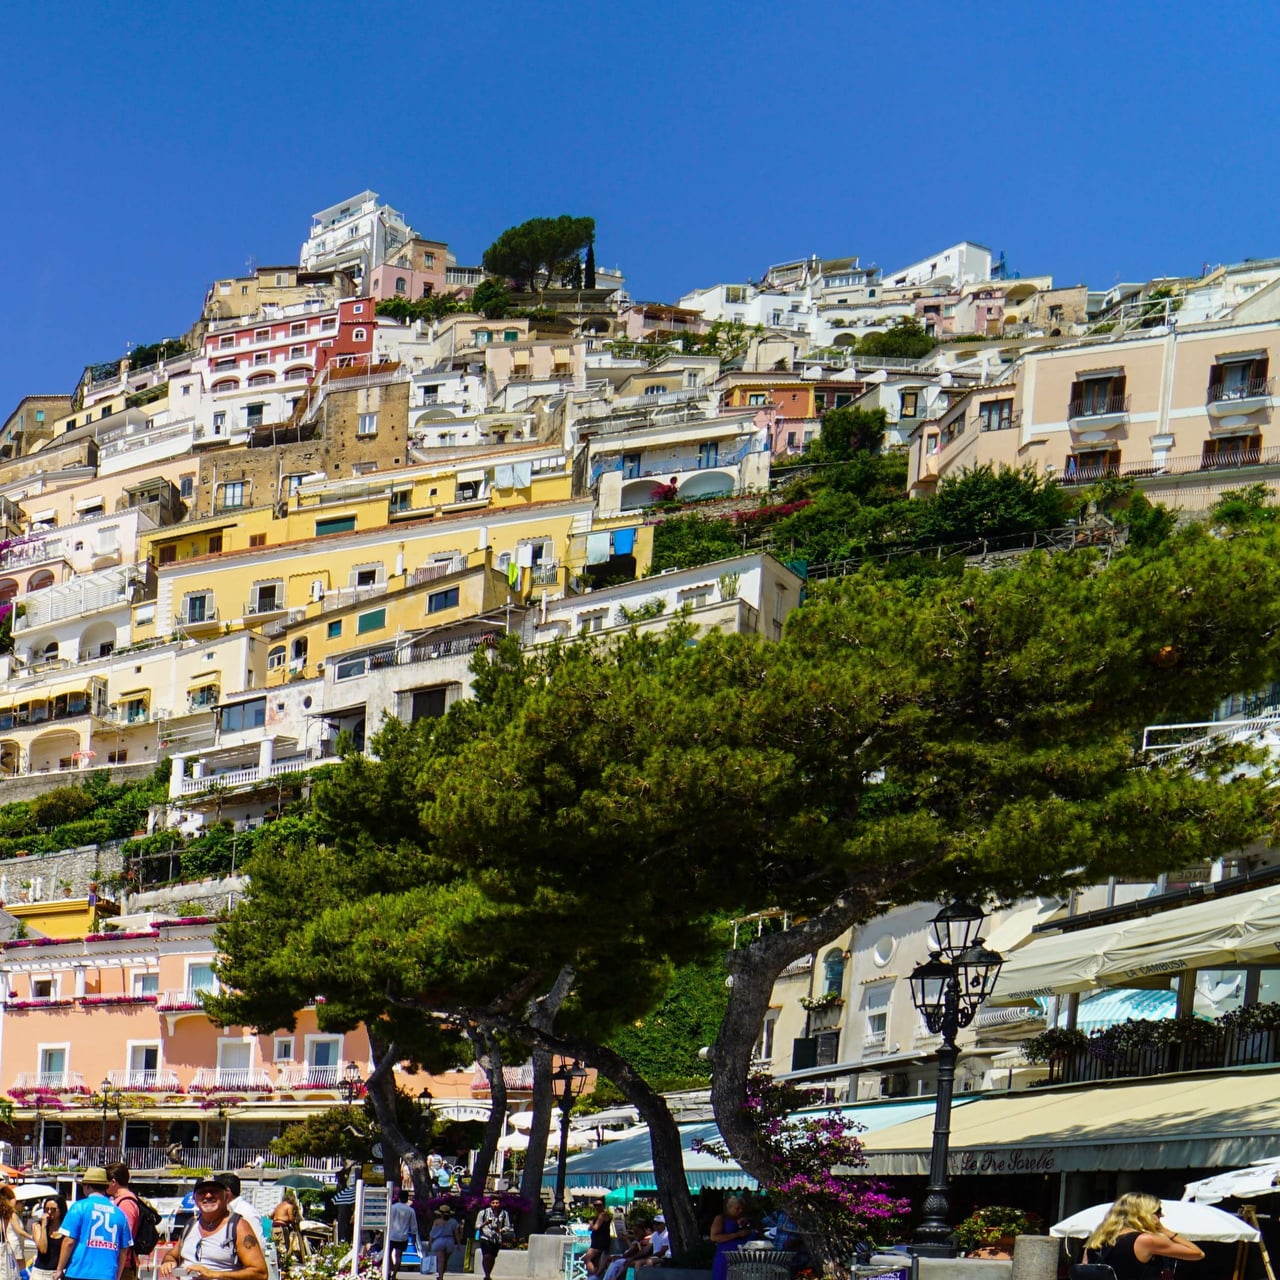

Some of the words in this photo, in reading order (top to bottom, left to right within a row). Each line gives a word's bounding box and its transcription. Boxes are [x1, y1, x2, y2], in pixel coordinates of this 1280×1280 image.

[1123, 968, 1139, 978] LA
[1139, 959, 1189, 975] CAMBUSA
[438, 1107, 490, 1120] ISTORANTE
[961, 1150, 978, 1171] Le
[981, 1150, 1006, 1171] Tre
[1008, 1148, 1055, 1170] Sorelle
[91, 1210, 118, 1242] 24
